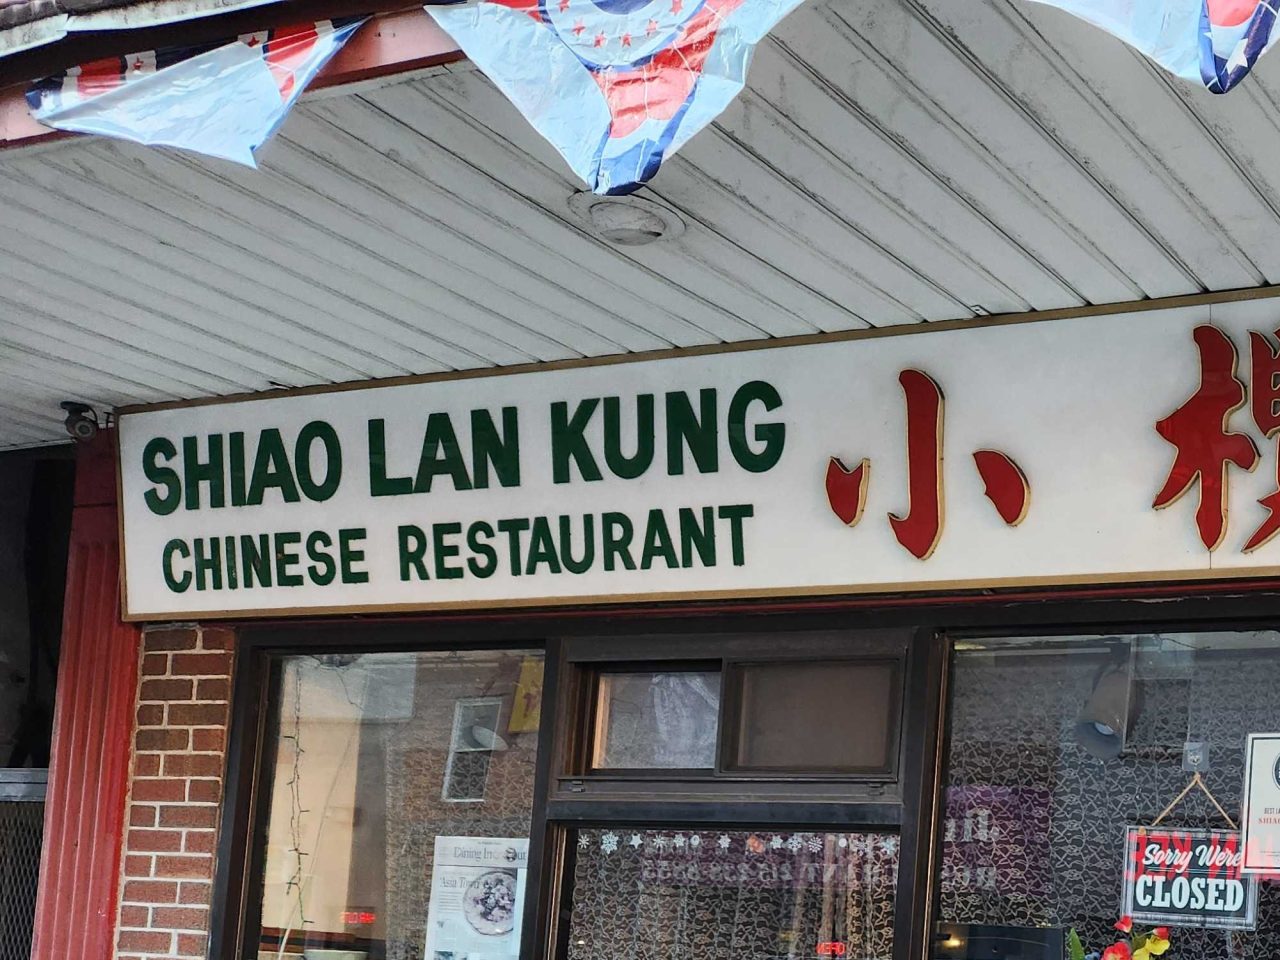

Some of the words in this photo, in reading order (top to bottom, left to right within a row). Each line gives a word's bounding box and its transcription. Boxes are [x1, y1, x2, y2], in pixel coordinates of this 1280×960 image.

[143, 420, 342, 516] SHIAO
[368, 406, 520, 497] LAN
[550, 380, 786, 484] KUNG
[162, 527, 369, 593] CHINESE
[398, 504, 754, 582] RESTAURANT
[453, 847, 482, 861] Dining
[1142, 844, 1193, 873] Sorry
[1136, 875, 1244, 912] CLOSED
